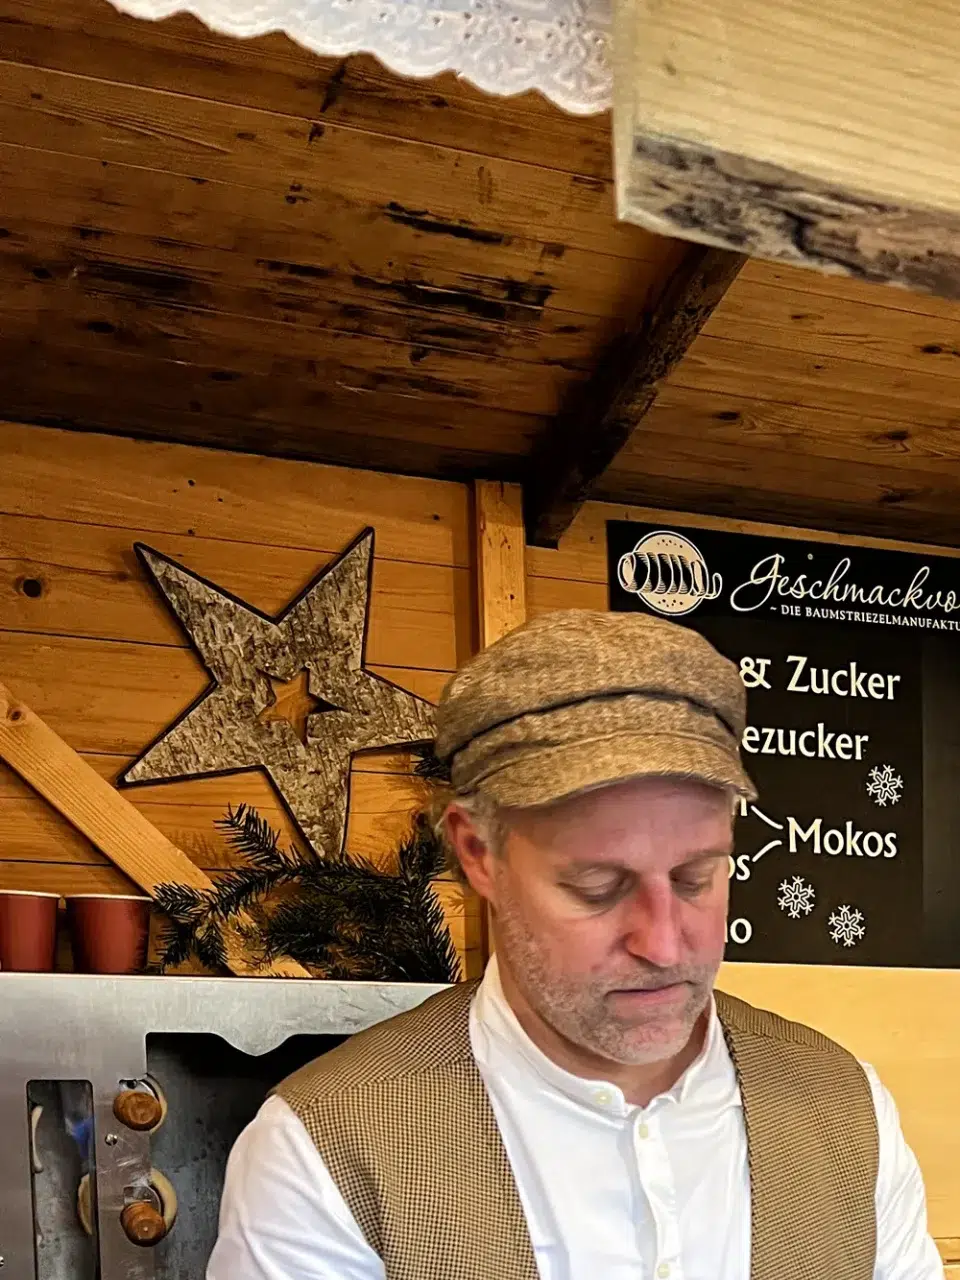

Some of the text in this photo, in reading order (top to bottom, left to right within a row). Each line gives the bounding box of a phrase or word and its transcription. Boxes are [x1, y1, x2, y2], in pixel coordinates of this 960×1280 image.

[781, 604, 801, 616] DIE
[739, 655, 901, 700] & Zucker
[736, 722, 869, 760] ezucker
[786, 816, 897, 858] Mokos
